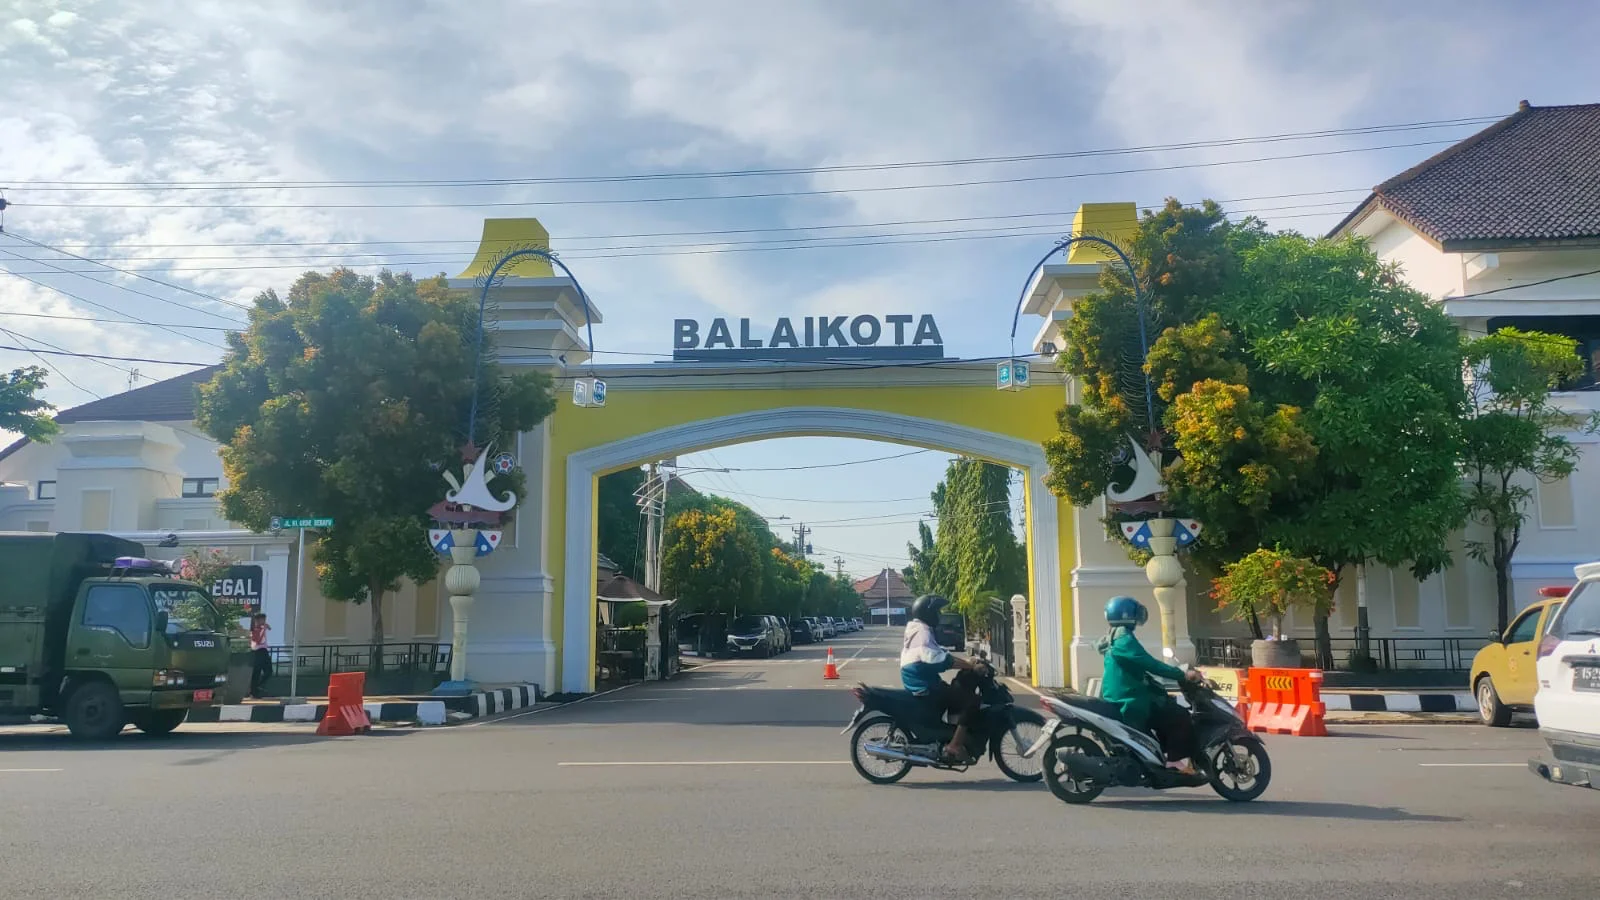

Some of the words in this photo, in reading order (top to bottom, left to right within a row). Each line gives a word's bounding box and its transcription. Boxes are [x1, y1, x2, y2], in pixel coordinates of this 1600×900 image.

[674, 314, 943, 349] BALAIKOTA
[206, 579, 258, 597] EGAL
[193, 640, 215, 648] ISUZU
